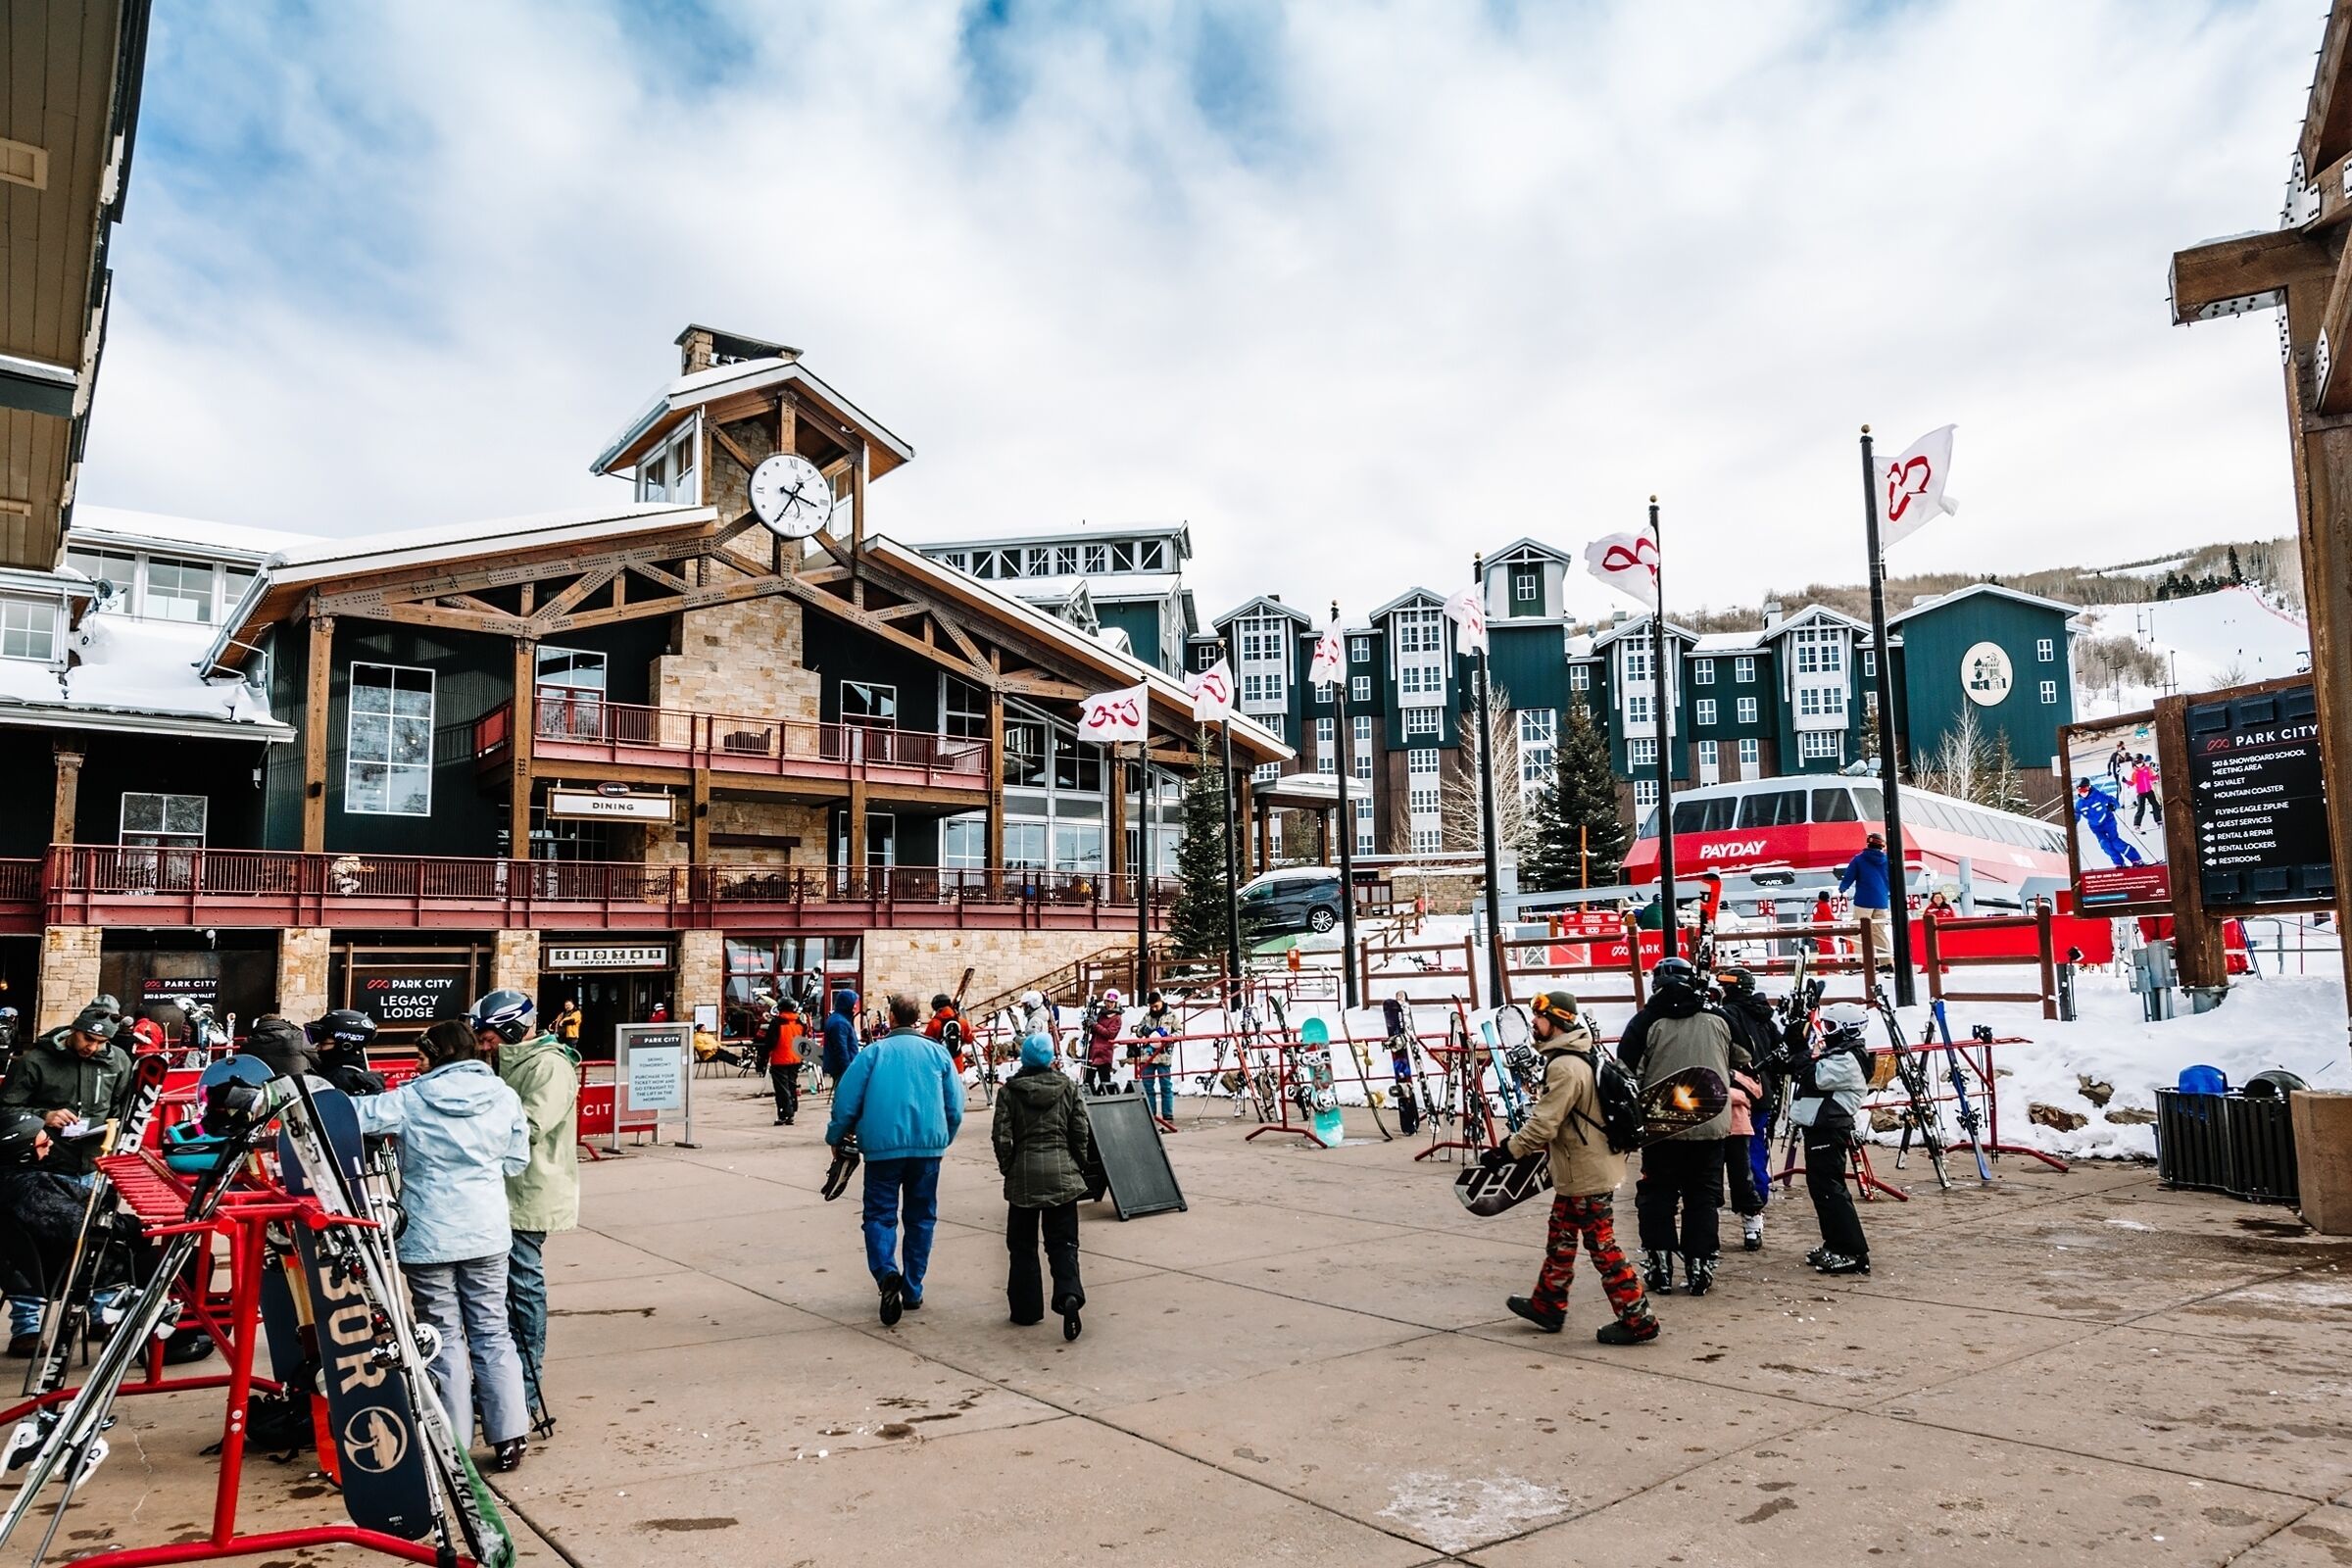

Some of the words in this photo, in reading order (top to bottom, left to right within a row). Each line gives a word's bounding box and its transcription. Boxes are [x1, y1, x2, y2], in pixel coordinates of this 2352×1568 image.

[2235, 731, 2276, 747] PARK
[2280, 724, 2319, 740] CITY
[2229, 753, 2274, 765] SNOWBOARD
[2275, 749, 2307, 760] SCHOOL
[2213, 765, 2243, 775] MEETING
[2224, 777, 2245, 786] VALET
[2214, 788, 2251, 799] MOUNTAIN
[2252, 785, 2284, 794] COASTER
[593, 802, 634, 810] DINING
[2239, 804, 2262, 812] EAGLE
[2263, 802, 2289, 810] ZIPLINE
[2216, 819, 2238, 828] GUEST
[2239, 816, 2273, 825] SERVICES
[2217, 831, 2242, 840] RENTAL
[1699, 840, 1767, 859] PAYDAY
[2218, 844, 2243, 853] RENTAL
[2244, 841, 2277, 850] LOCKERS
[2219, 855, 2262, 864] RESTROOMS
[1638, 944, 1660, 955] ARK
[424, 979, 453, 988] CITY
[380, 996, 439, 1005] LEGACY
[383, 1007, 434, 1018] LODGE
[118, 1084, 163, 1154] ÖLKL
